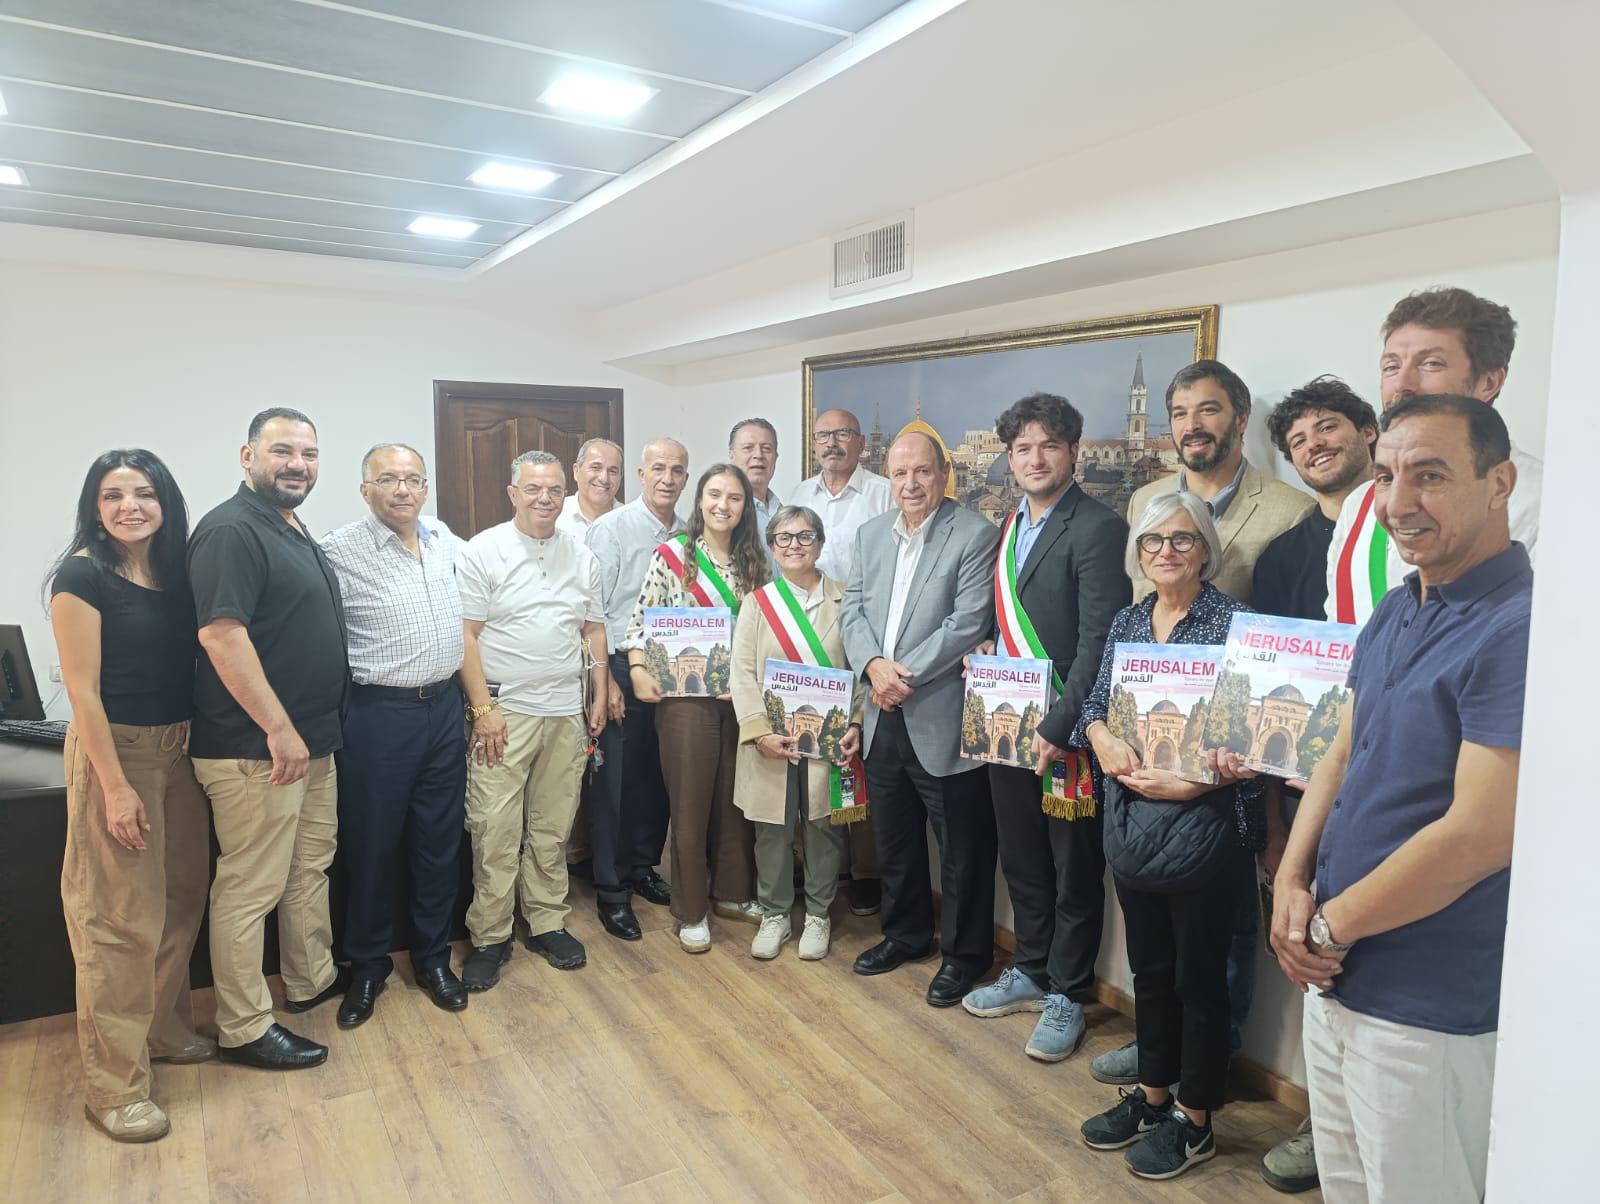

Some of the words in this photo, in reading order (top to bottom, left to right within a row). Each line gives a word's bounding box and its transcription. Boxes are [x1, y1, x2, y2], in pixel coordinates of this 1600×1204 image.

[651, 618, 725, 628] JERUSALEM
[651, 629, 679, 638] القدس
[1121, 658, 1216, 676] JERUSALEM
[972, 667, 1042, 685] JERUSALEM
[1120, 673, 1154, 684] القدس
[771, 672, 847, 692] JERUSALEM
[972, 680, 997, 689] القدس
[771, 683, 798, 692] القدس
